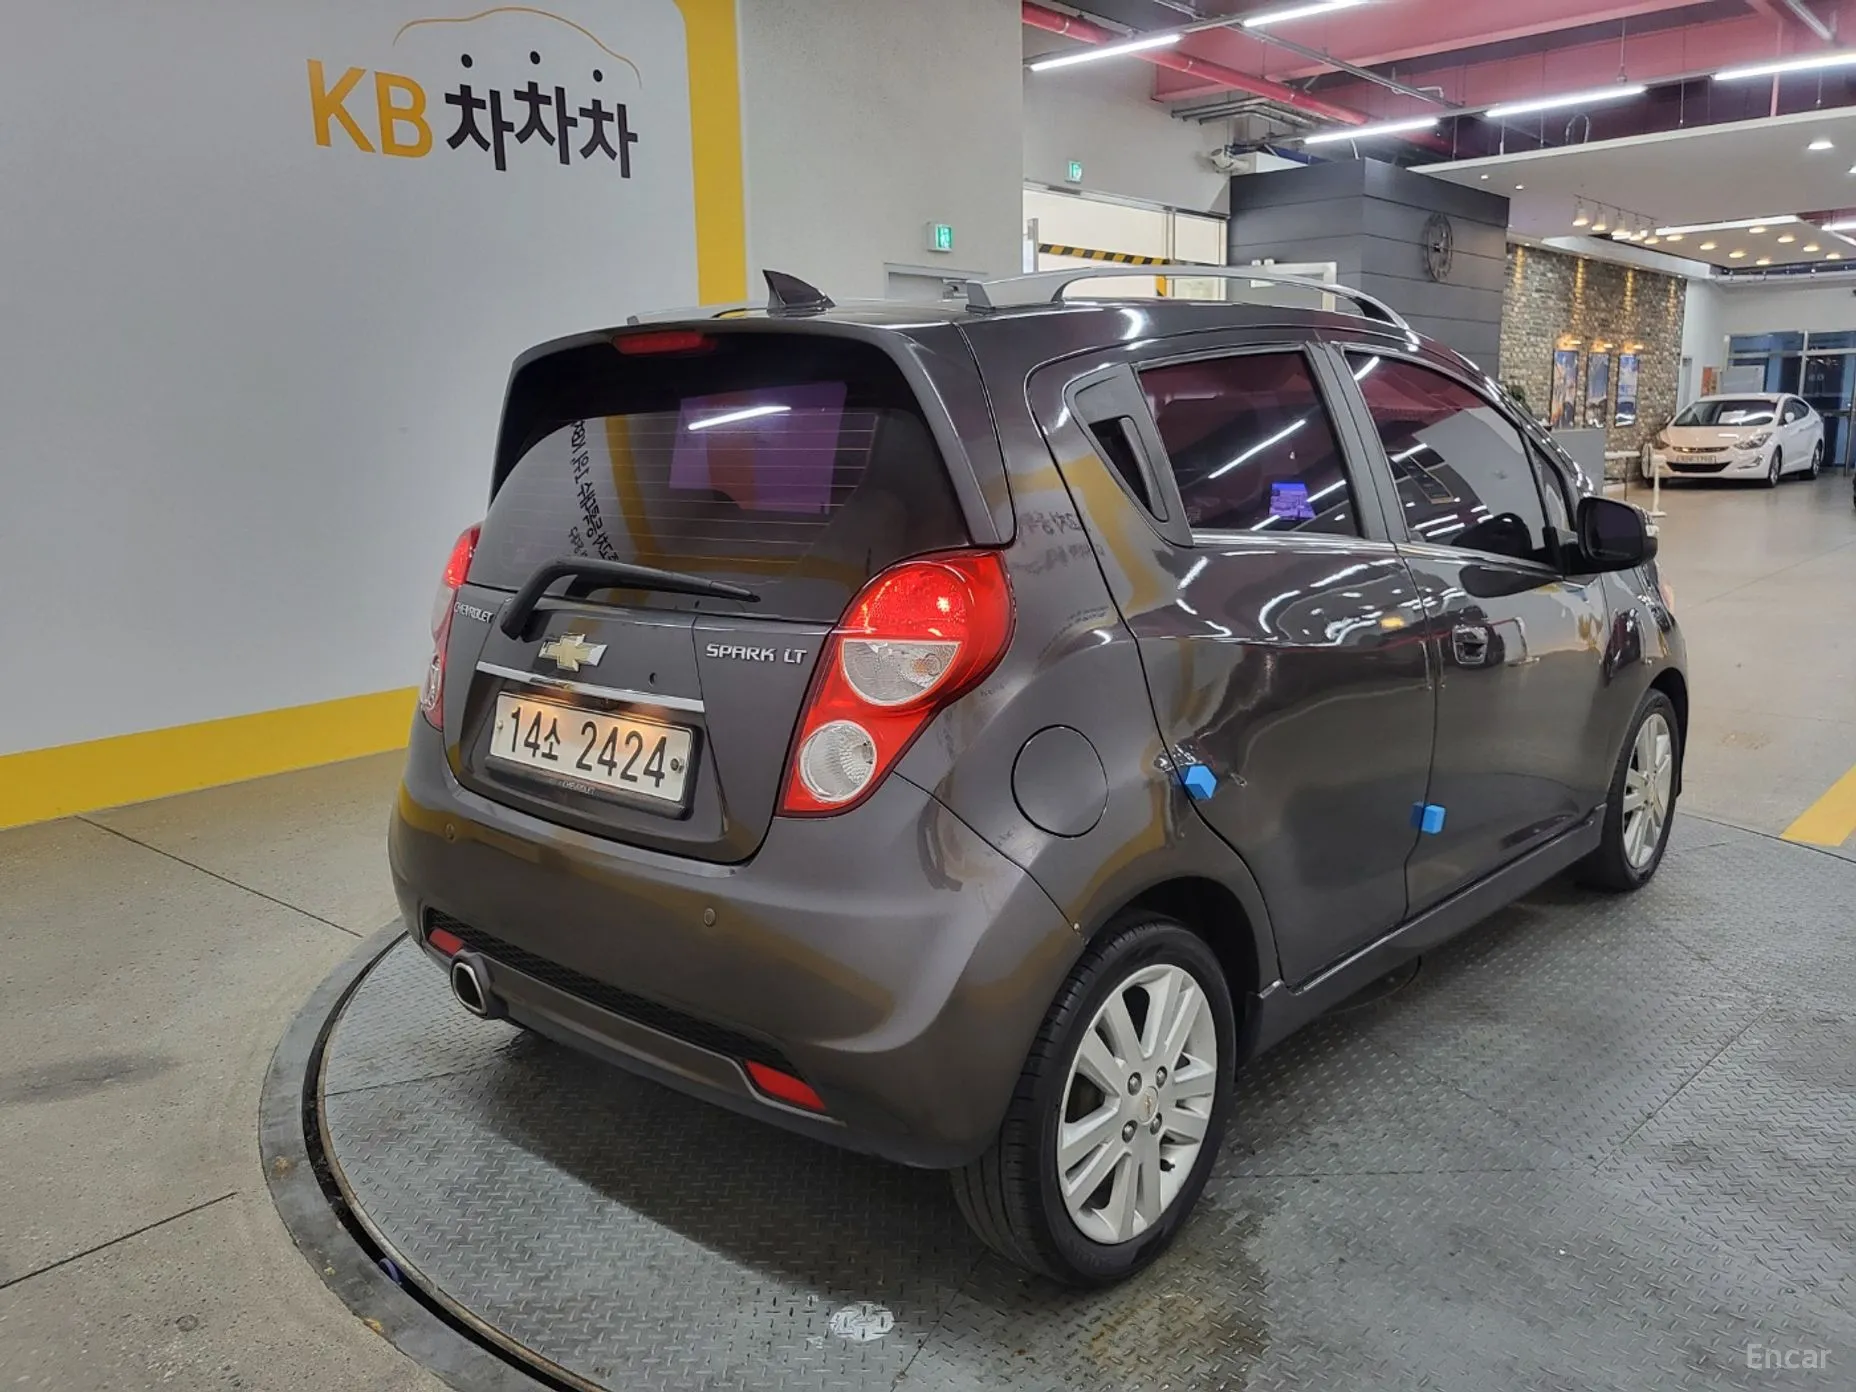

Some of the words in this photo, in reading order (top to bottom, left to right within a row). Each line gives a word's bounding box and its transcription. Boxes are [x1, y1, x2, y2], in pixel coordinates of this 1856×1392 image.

[706, 643, 776, 661] SPARK
[783, 648, 807, 664] LT
[511, 706, 561, 761] 14소
[576, 721, 667, 788] 2424
